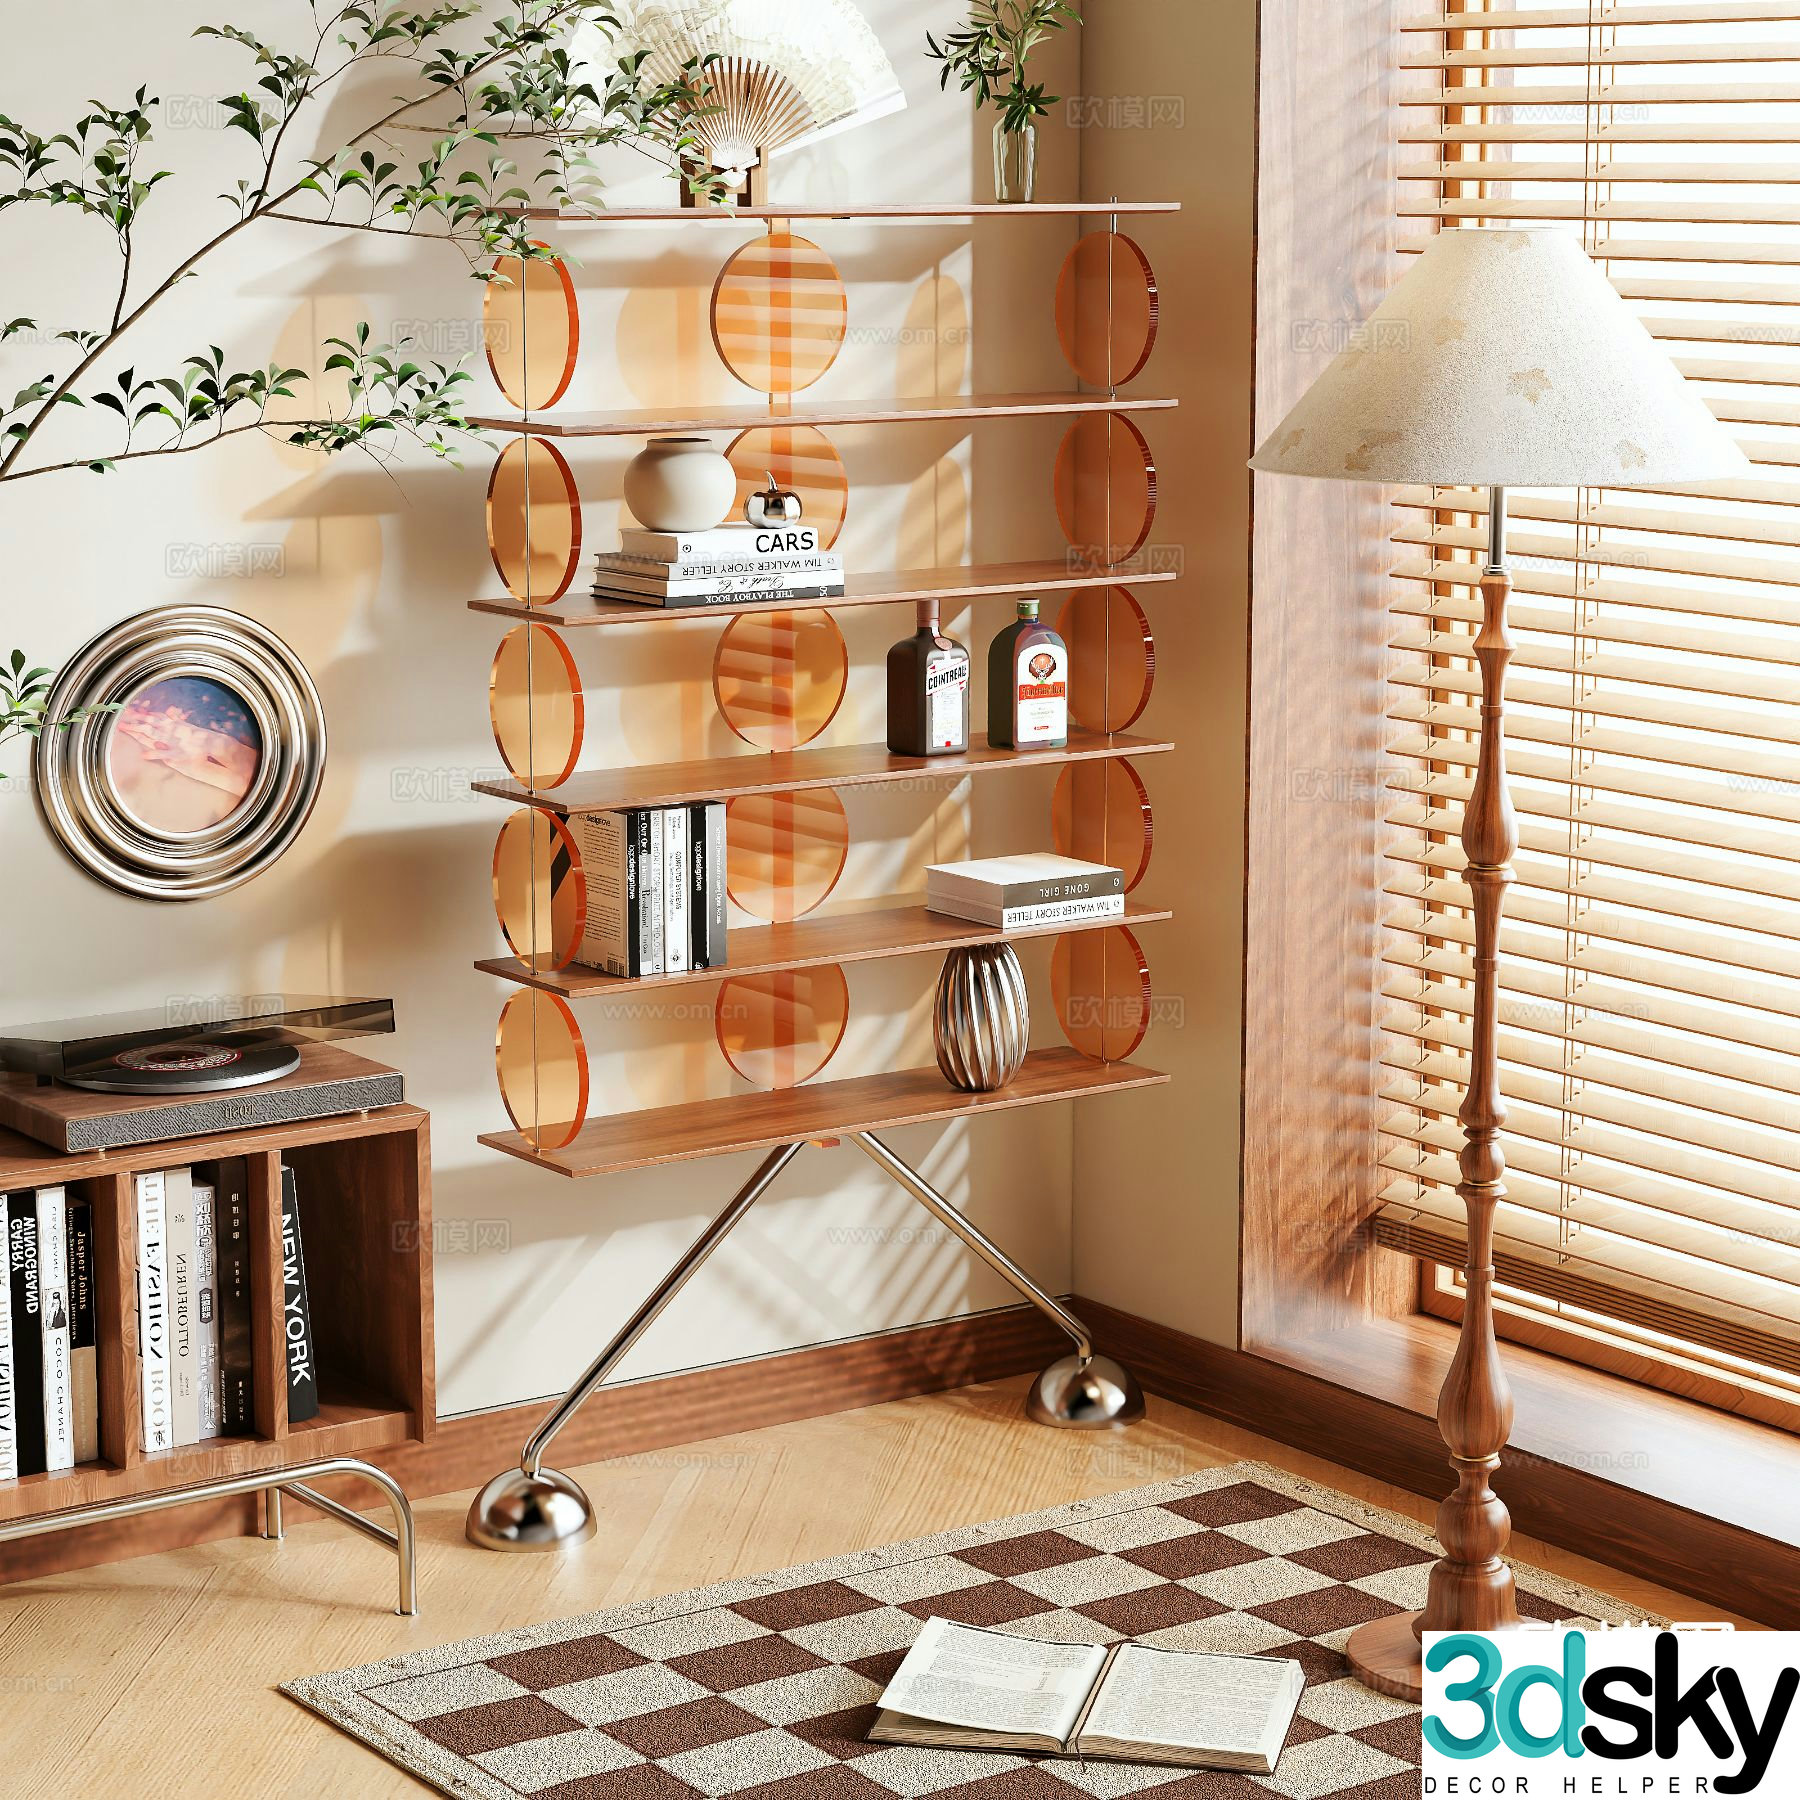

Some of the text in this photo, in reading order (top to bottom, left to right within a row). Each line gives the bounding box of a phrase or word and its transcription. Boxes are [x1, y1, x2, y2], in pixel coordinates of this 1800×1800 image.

[755, 531, 814, 553] CARS
[682, 557, 822, 576] TIM WALKER STORY TELLER
[705, 588, 794, 604] THE PLAYBOY BOOK
[1040, 882, 1090, 898] GONE GIRL
[1007, 909, 1033, 923] TELLER
[1063, 902, 1095, 916] WALKER
[76, 1231, 88, 1310] Jasper Johns
[282, 1214, 312, 1386] NEW YORK
